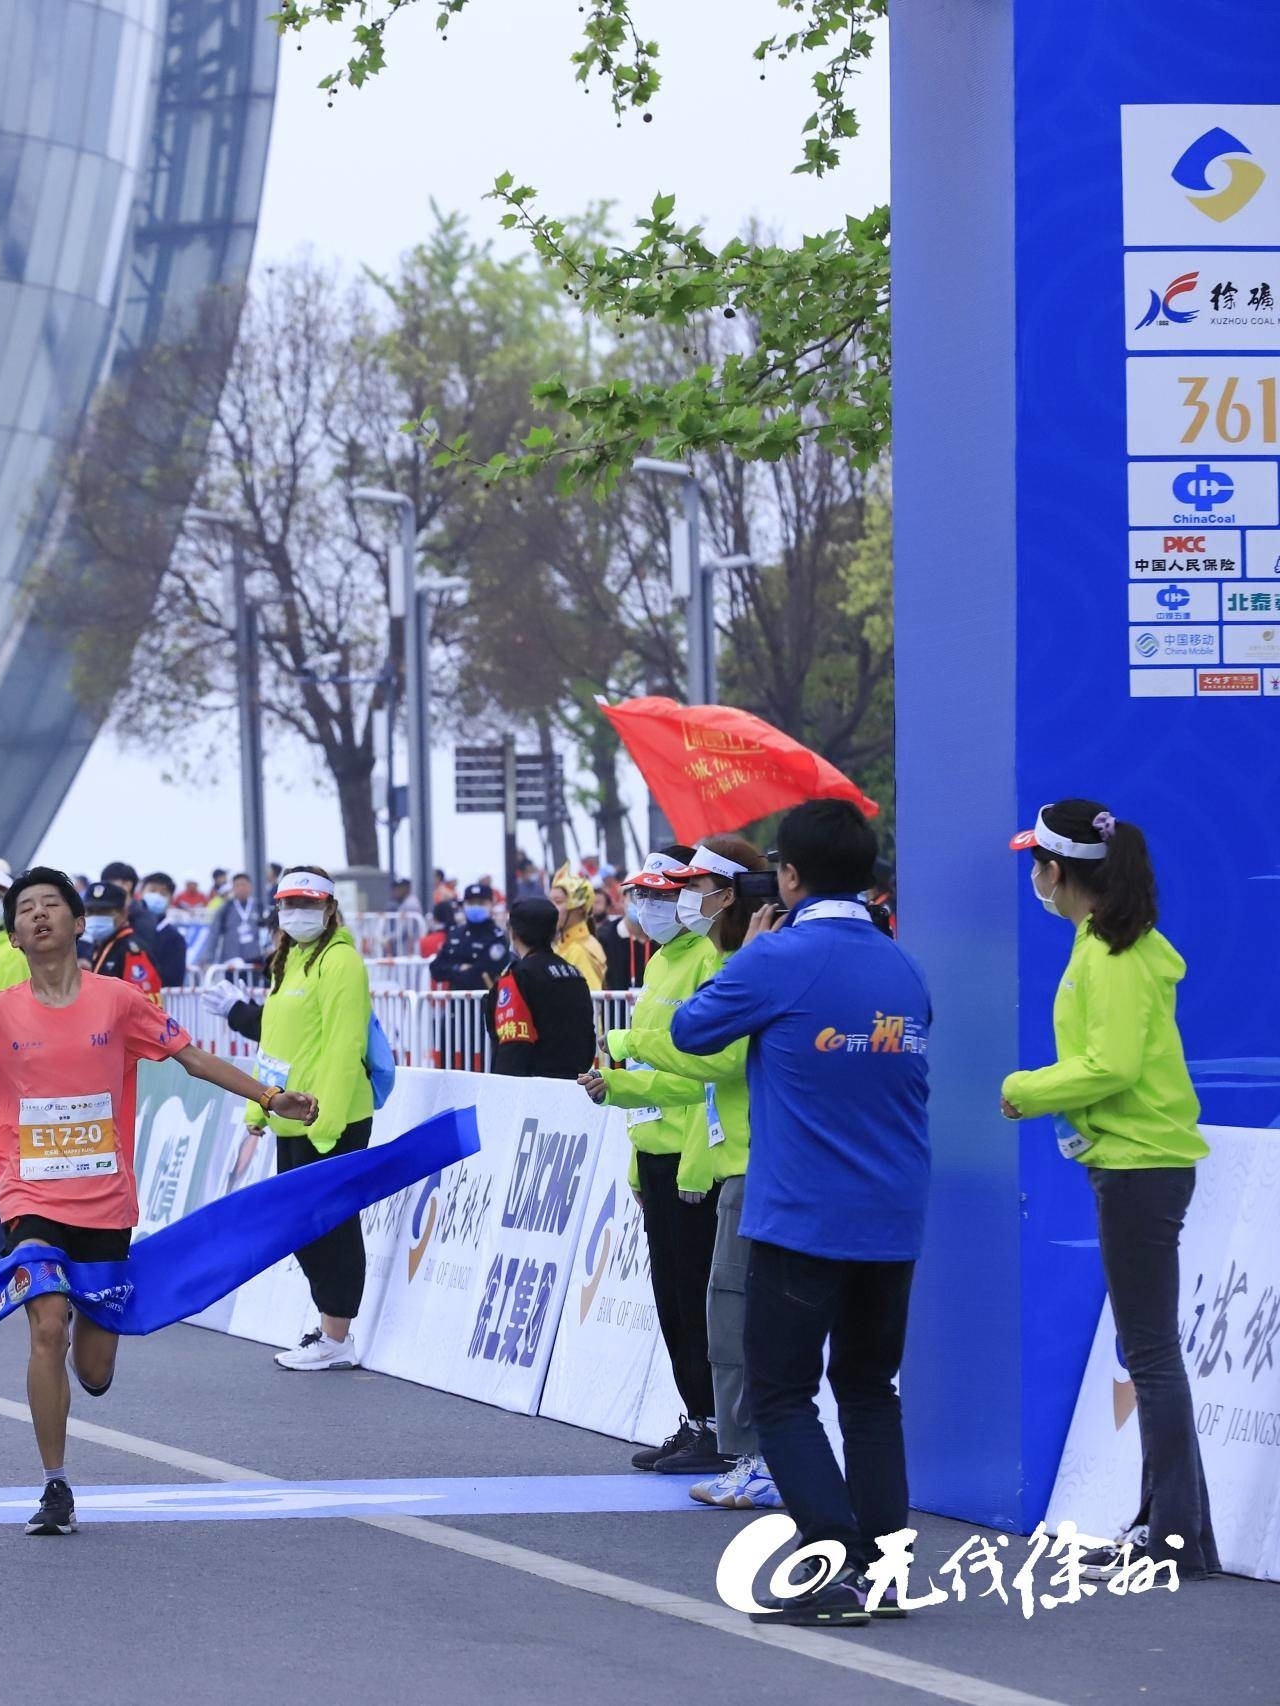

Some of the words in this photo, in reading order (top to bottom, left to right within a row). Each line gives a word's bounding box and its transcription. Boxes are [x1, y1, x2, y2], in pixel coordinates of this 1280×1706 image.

[1177, 376, 1277, 444] 361
[1172, 514, 1236, 524] ChinaCoal
[1163, 535, 1207, 553] PICC
[1134, 558, 1236, 573] 中国人民保险
[1164, 633, 1215, 646] 中国移动
[1164, 647, 1188, 655] China
[1188, 647, 1215, 655] Mobile
[31, 1124, 102, 1147] E1720
[467, 1252, 557, 1368] 徐工集团
[1196, 1402, 1225, 1437] OF
